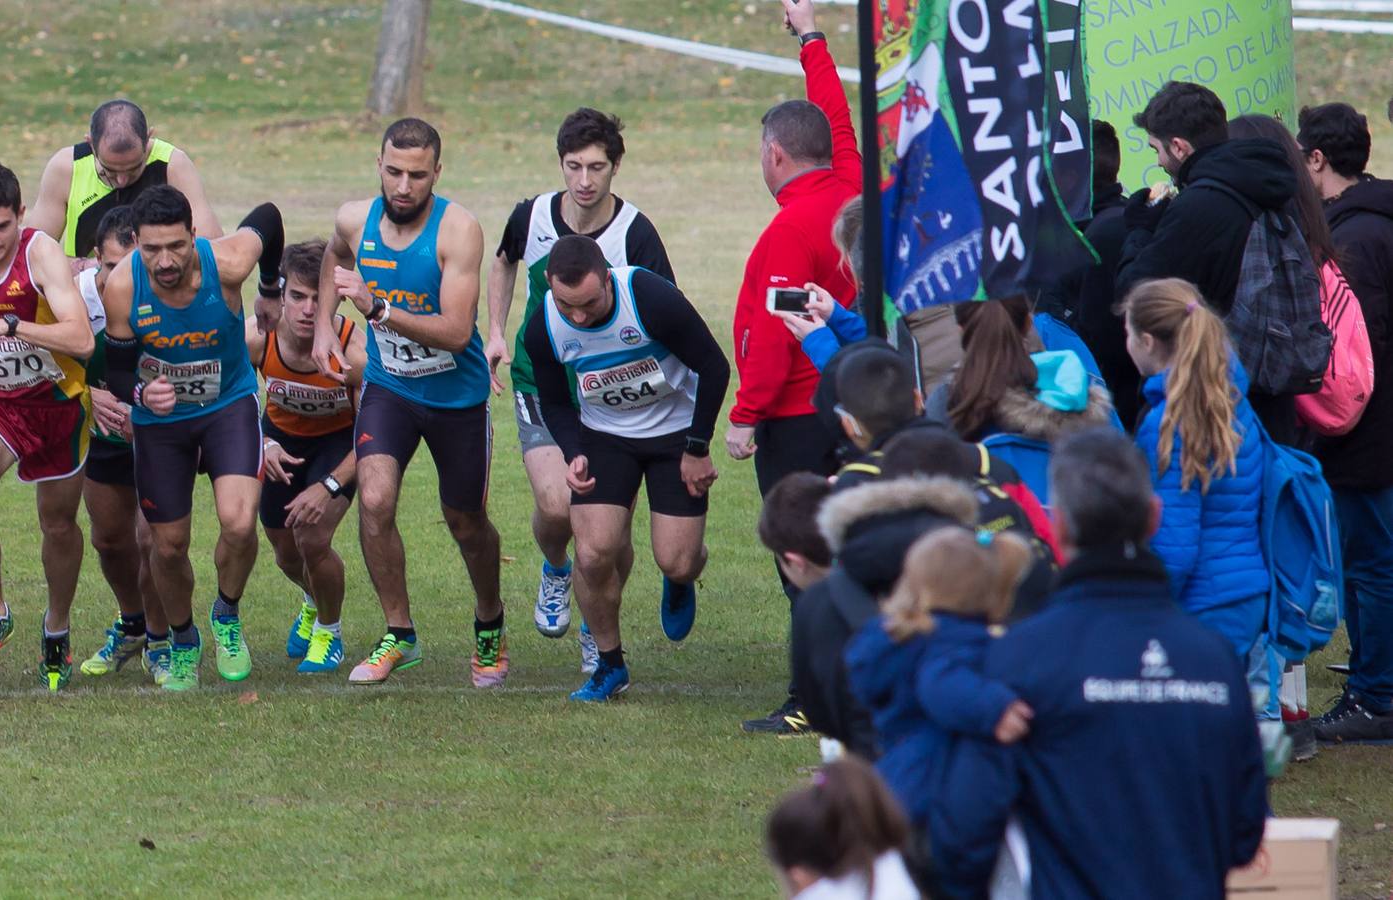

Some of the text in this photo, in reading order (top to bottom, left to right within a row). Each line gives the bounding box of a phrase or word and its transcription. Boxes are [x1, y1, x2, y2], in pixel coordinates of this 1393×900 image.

[1104, 2, 1240, 67] CALZADA
[1226, 36, 1257, 72] DE
[948, 0, 1025, 262] SANTO
[601, 361, 659, 386] ATLETISMO
[603, 381, 658, 406] 664
